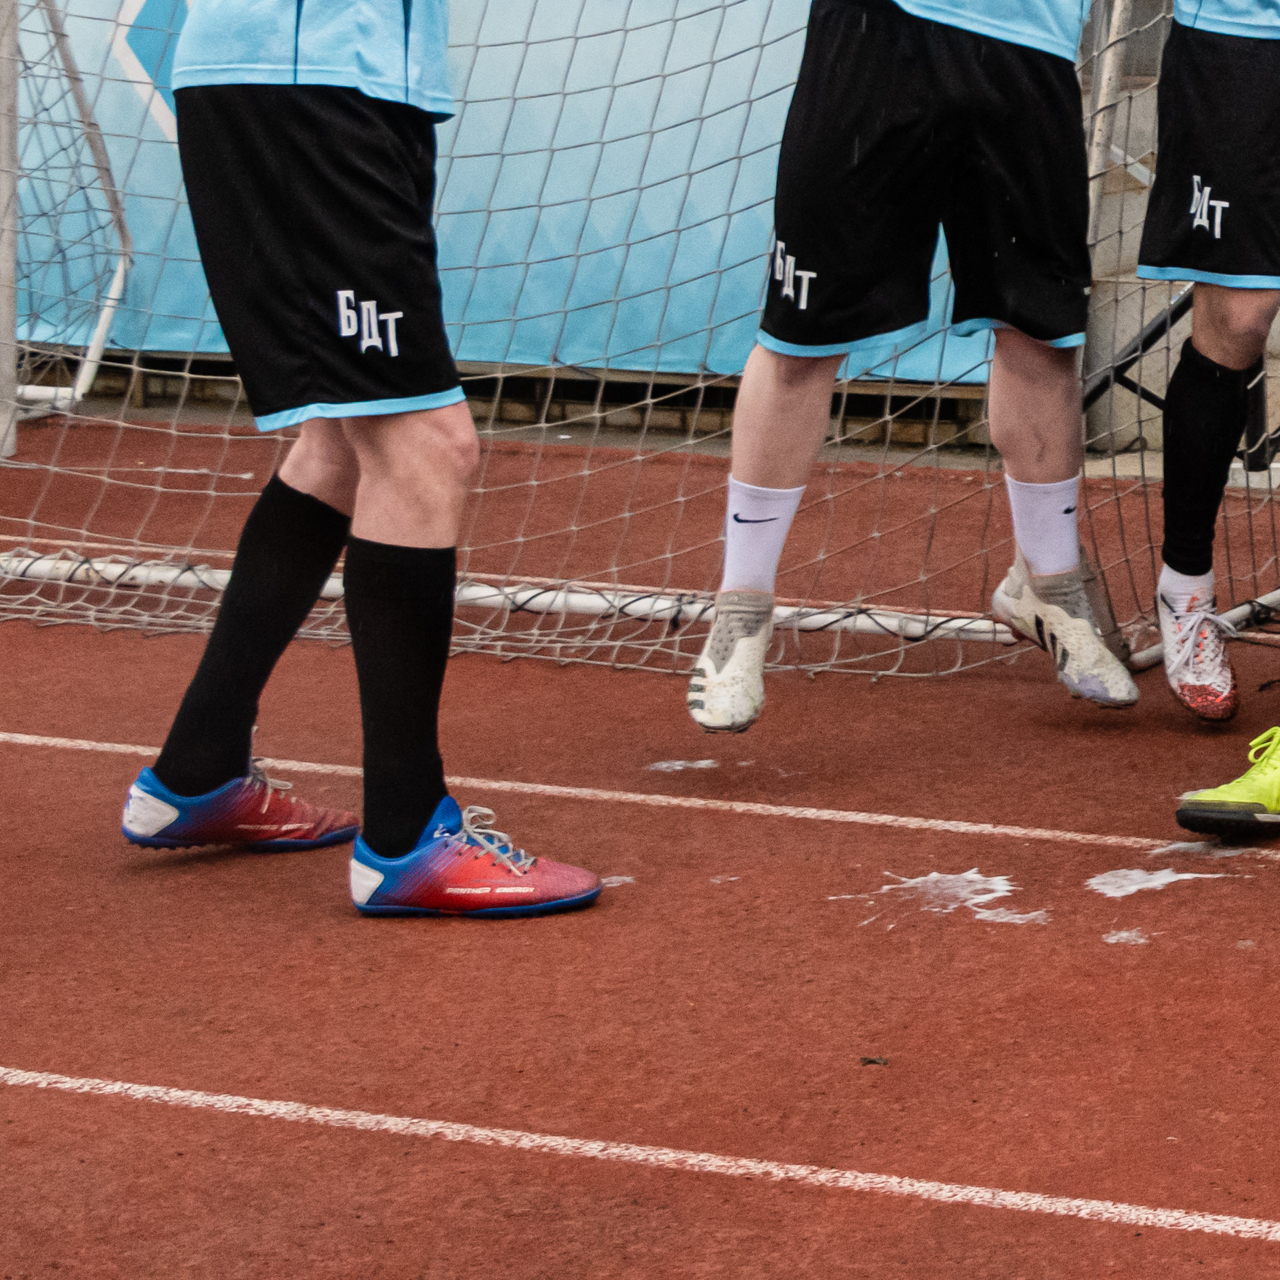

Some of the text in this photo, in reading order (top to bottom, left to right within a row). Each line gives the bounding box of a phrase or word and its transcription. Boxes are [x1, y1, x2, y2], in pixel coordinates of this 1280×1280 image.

[1190, 174, 1230, 239] БДТ
[774, 240, 818, 310] БДТ
[336, 289, 404, 357] БДТ
